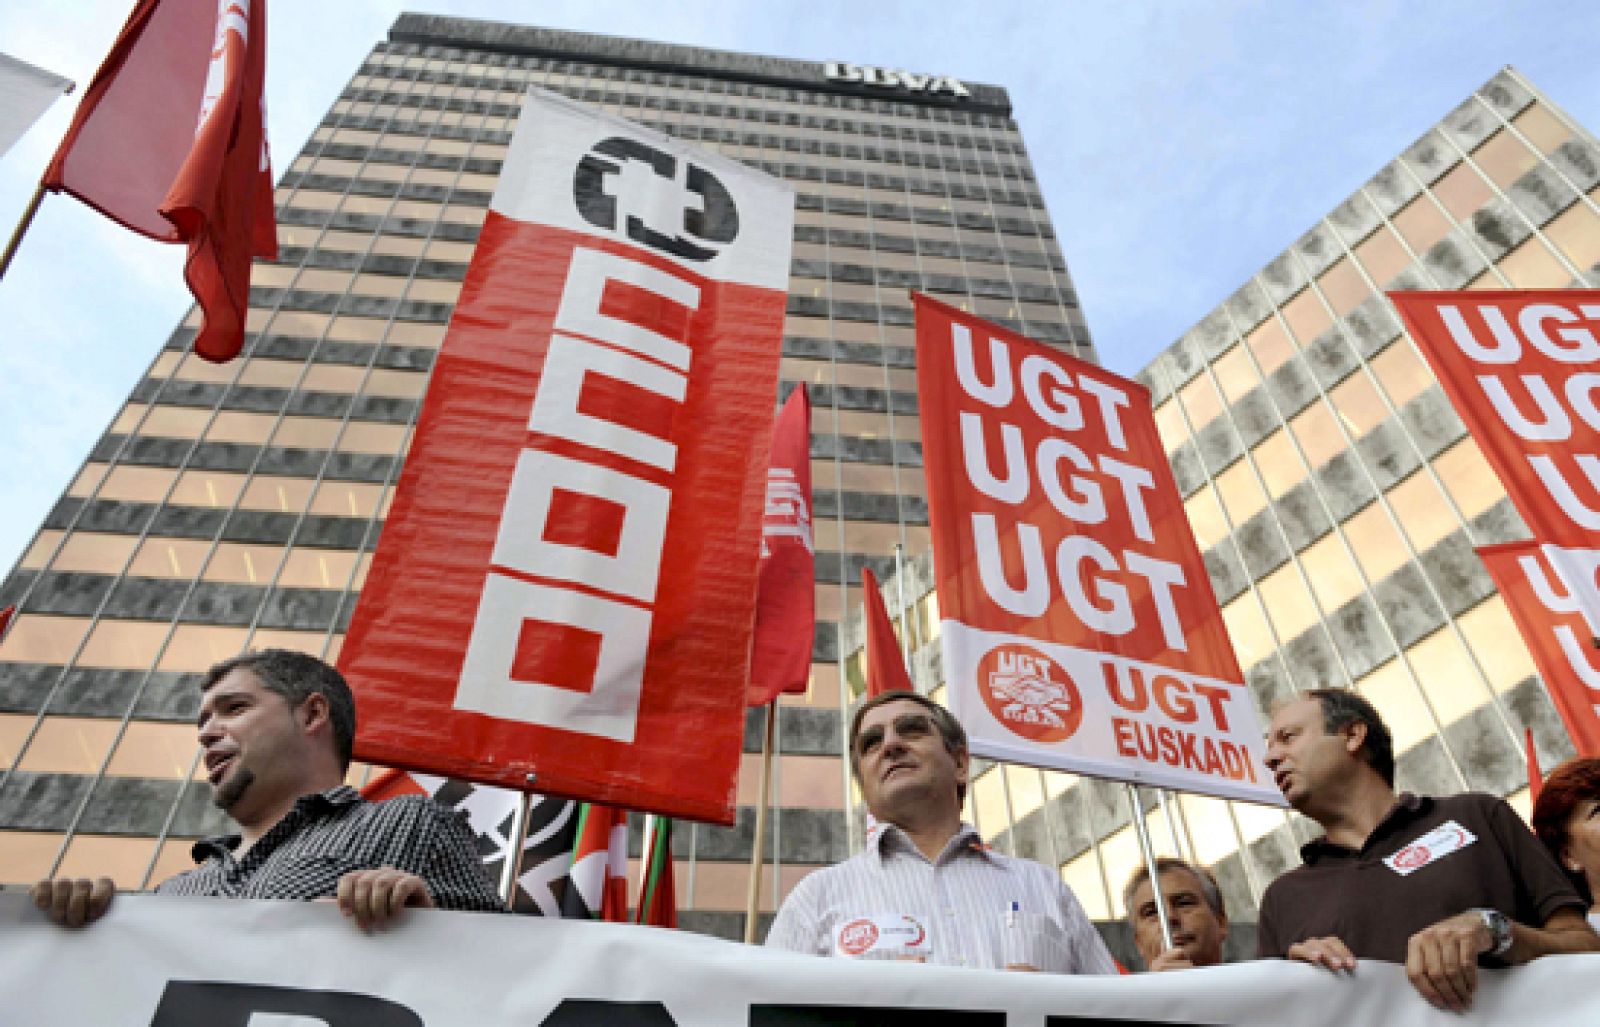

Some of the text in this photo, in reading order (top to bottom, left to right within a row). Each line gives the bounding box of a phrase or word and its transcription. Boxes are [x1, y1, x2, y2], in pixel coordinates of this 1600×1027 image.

[951, 322, 1130, 451] UGT
[960, 412, 1156, 543] UGT
[971, 512, 1188, 652] UGT
[1102, 662, 1231, 731] UGT
[1111, 717, 1257, 784] EUSKADI
